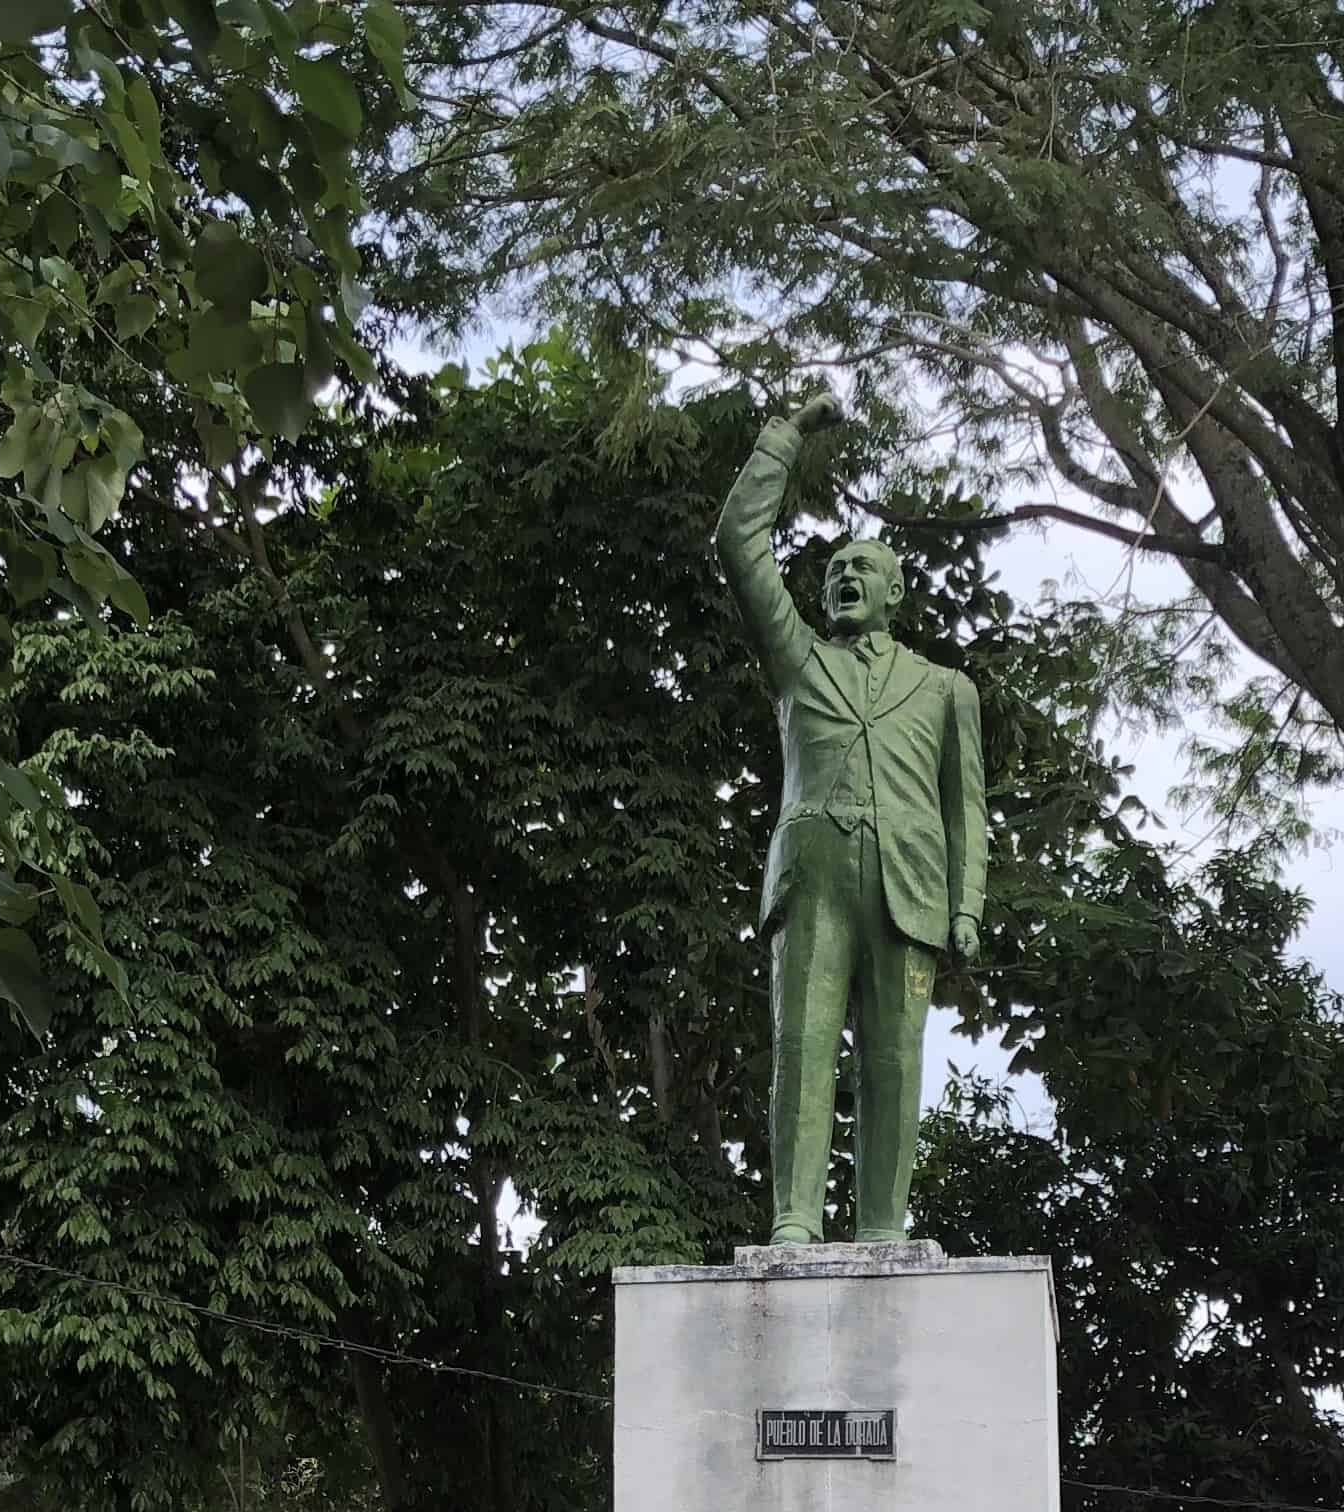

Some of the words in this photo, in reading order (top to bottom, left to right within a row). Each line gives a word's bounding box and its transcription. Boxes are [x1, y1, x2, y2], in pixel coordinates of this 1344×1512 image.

[766, 1419, 806, 1446] PUEBLO
[809, 1419, 824, 1446] DE
[827, 1419, 841, 1446] LA
[845, 1419, 888, 1446] DORADA
